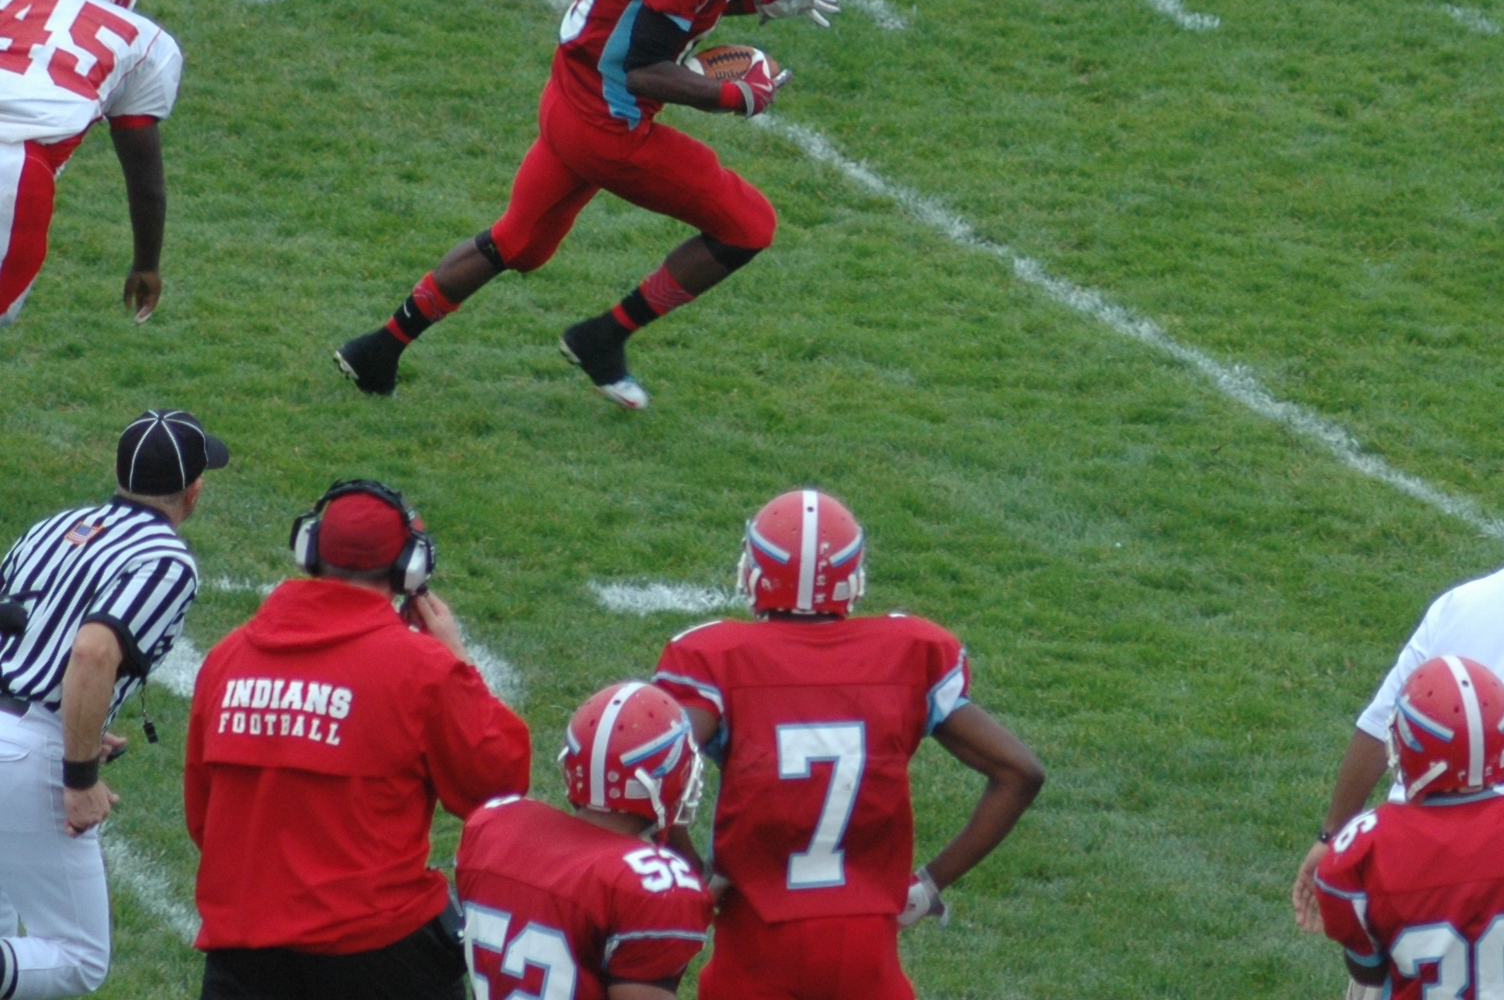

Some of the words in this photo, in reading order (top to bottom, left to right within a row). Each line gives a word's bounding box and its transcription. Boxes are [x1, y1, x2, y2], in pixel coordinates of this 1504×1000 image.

[221, 677, 353, 720] INDIANS
[217, 710, 341, 746] FOOTBALL
[776, 721, 866, 890] 7
[623, 847, 702, 893] 52
[463, 900, 577, 1000] 52
